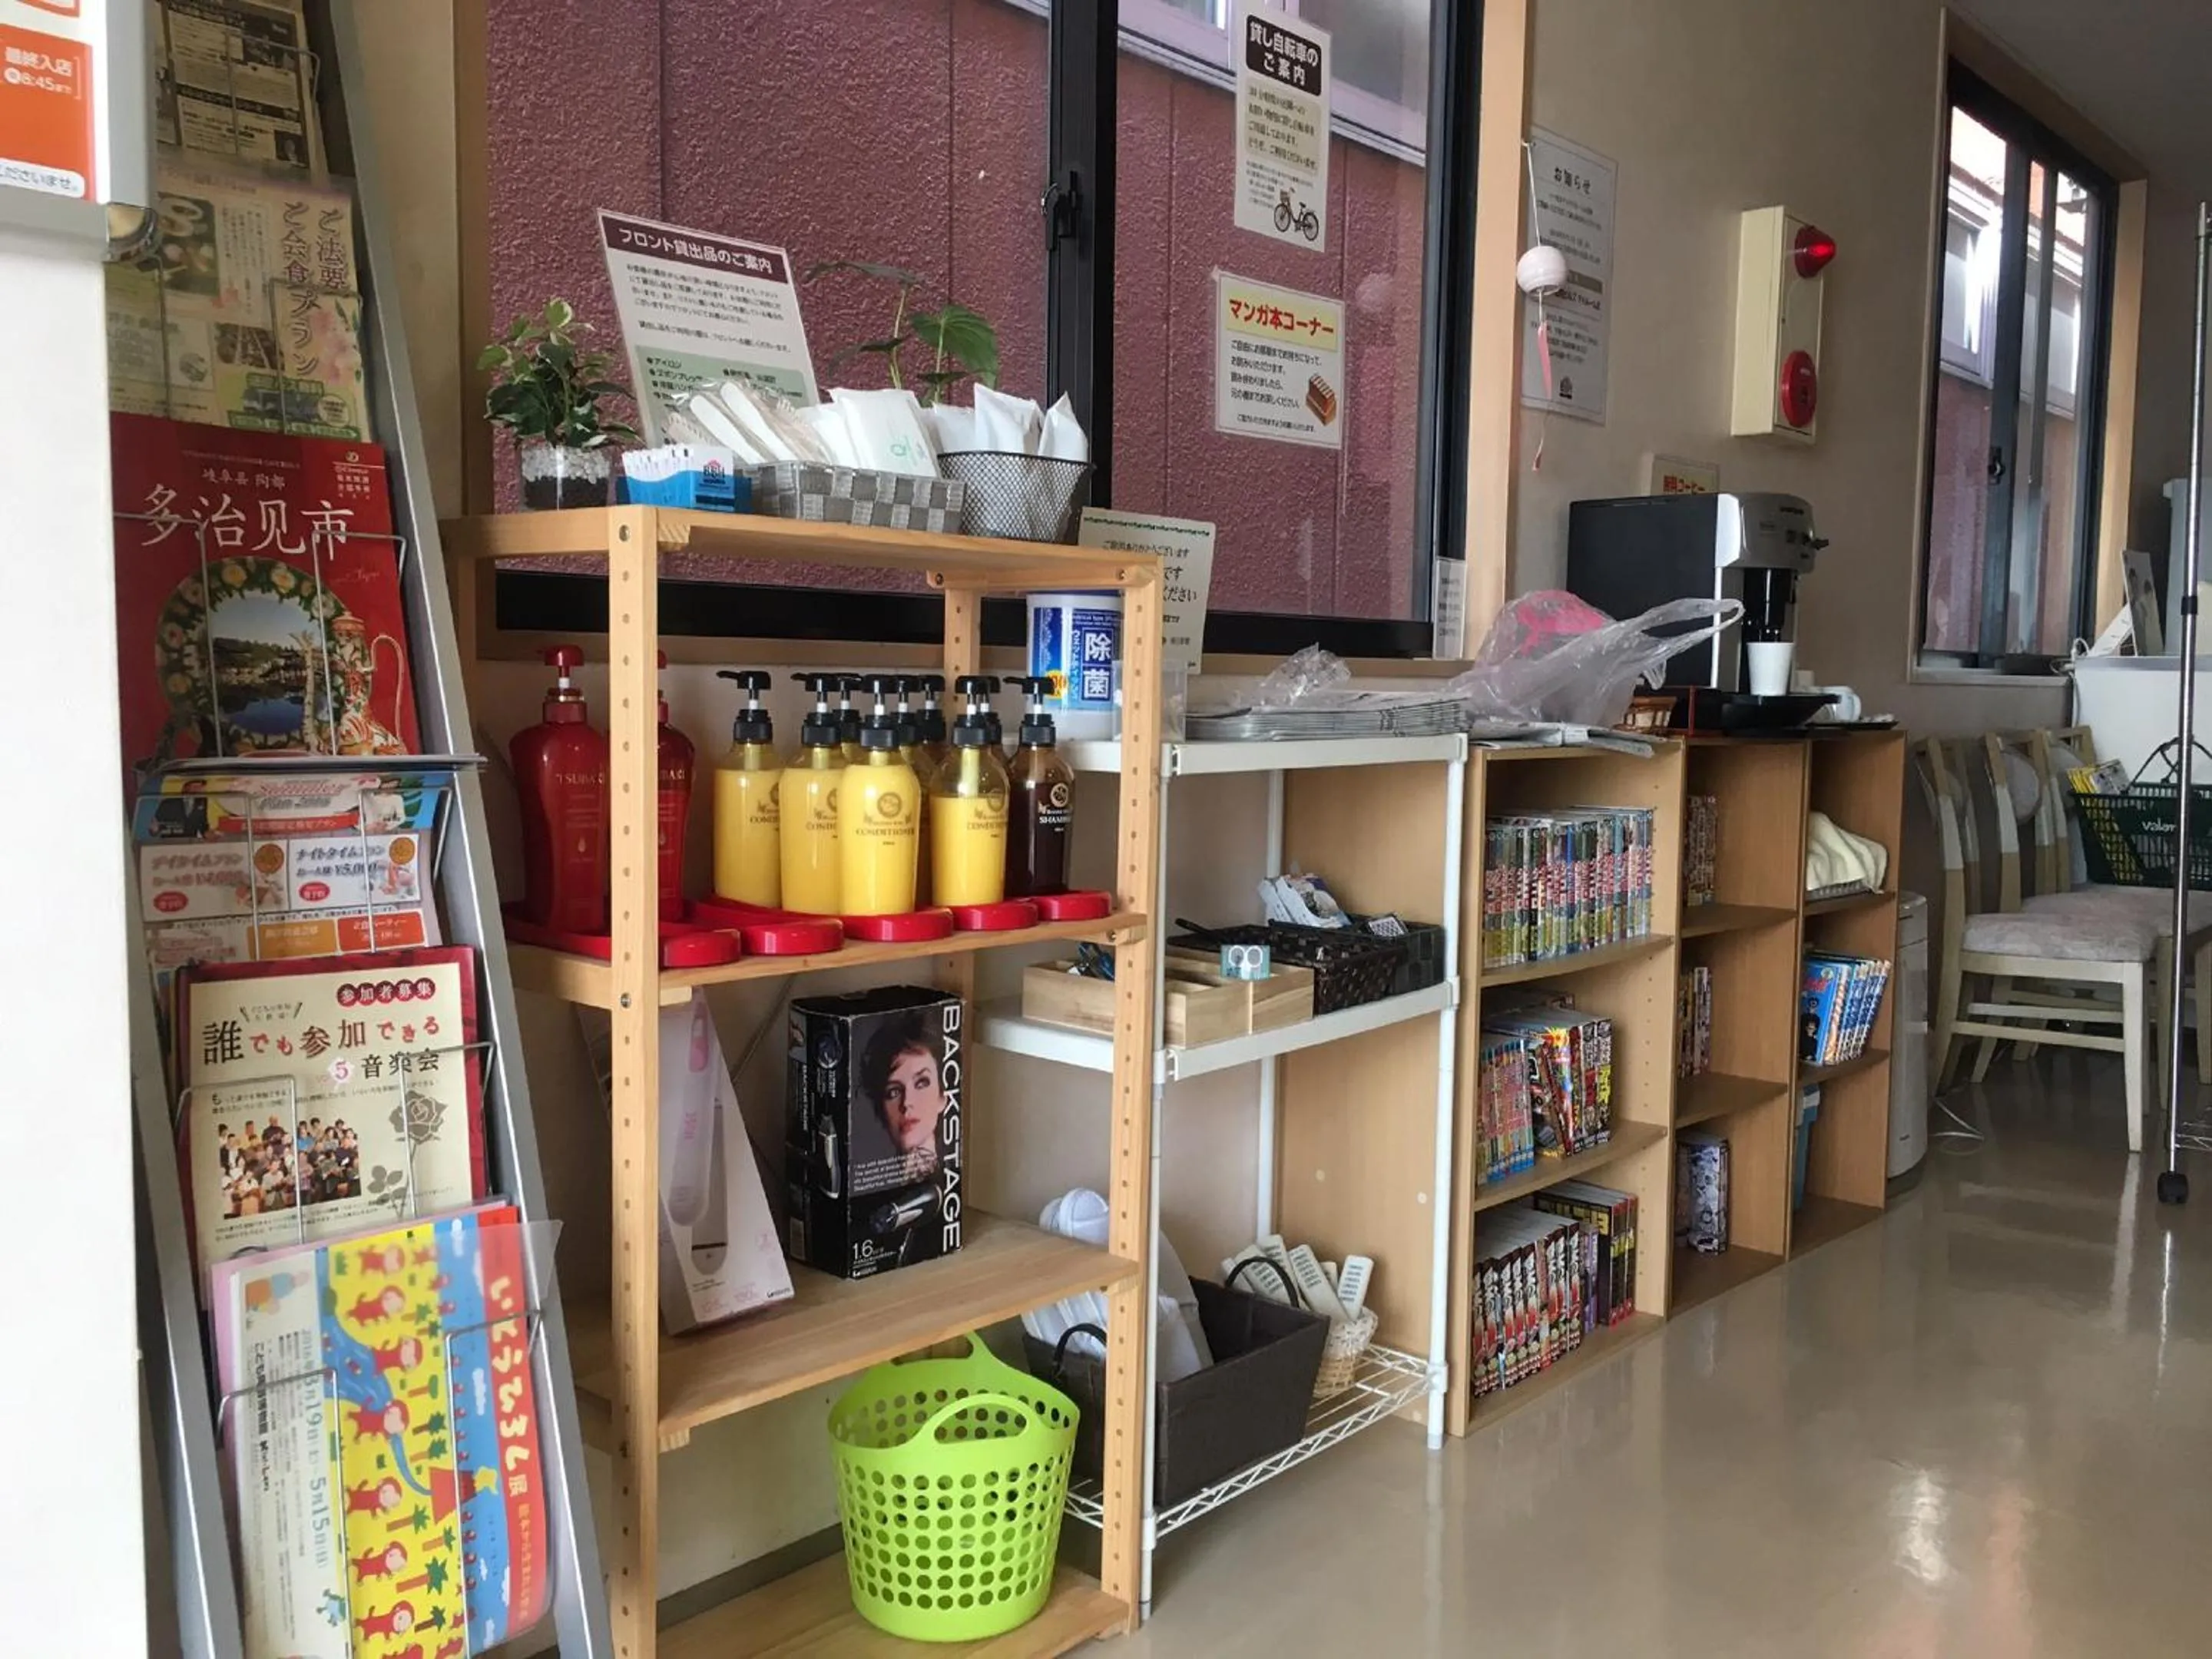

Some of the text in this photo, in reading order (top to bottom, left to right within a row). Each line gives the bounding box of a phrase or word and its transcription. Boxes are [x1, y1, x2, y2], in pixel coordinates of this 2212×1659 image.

[1250, 22, 1319, 67] 貸し自転車の
[1555, 167, 1591, 194] お知らせ
[618, 228, 773, 274] フロント貸出品のご案内
[1229, 299, 1334, 336] マンガ本コーナー
[141, 482, 355, 561] 多治见市
[1084, 632, 1111, 698] 除菌
[341, 979, 432, 1003] 参加者募集
[202, 1015, 440, 1066] 誰でも参加できる
[362, 1047, 440, 1079] 音楽会
[942, 1005, 960, 1253] BACKSTAGE
[853, 1239, 873, 1260] 1.6
[490, 1276, 531, 1497] いとうひろし展
